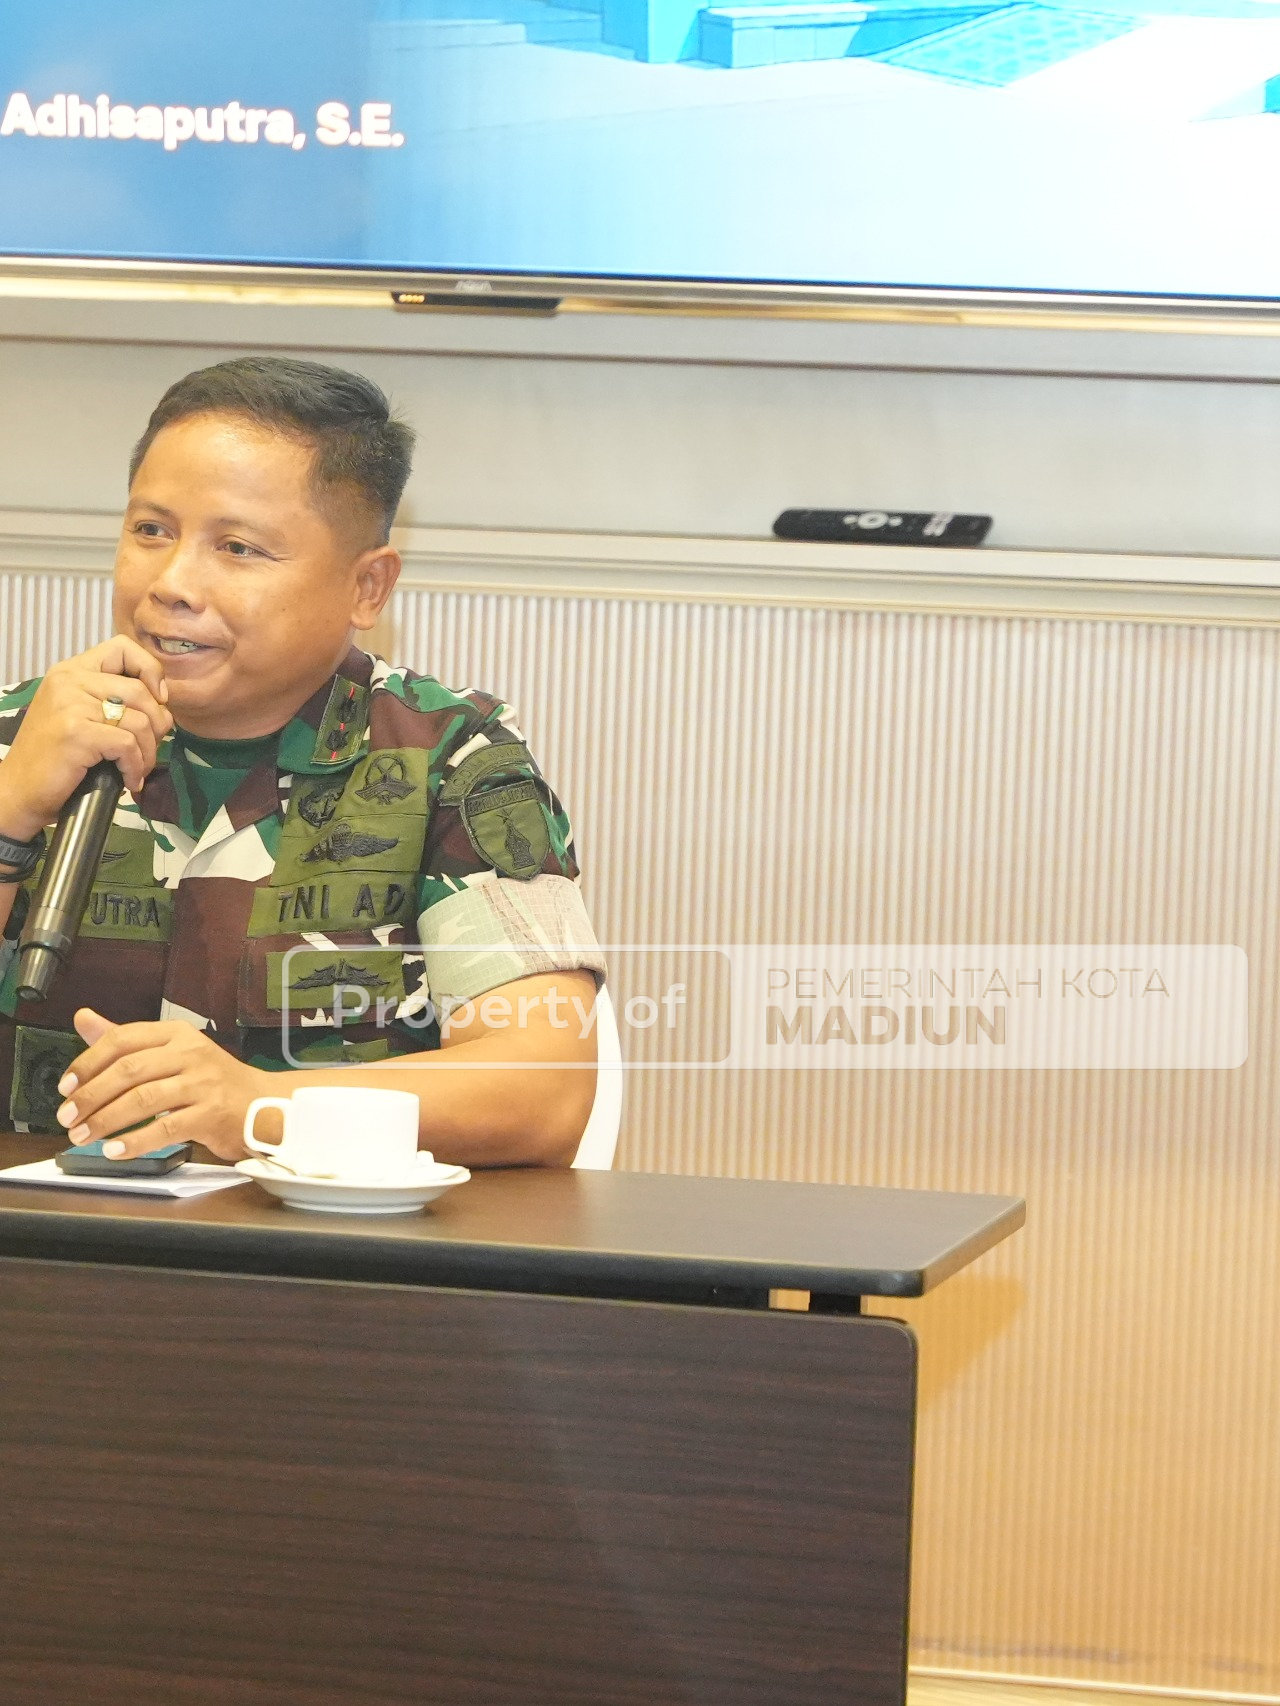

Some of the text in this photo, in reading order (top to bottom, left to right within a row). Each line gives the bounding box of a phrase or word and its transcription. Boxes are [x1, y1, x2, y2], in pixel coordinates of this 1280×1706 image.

[0, 92, 306, 150] Adhisaputra,
[316, 102, 405, 148] S.E.
[90, 892, 160, 928] UTRA
[278, 883, 406, 922] TNI AD
